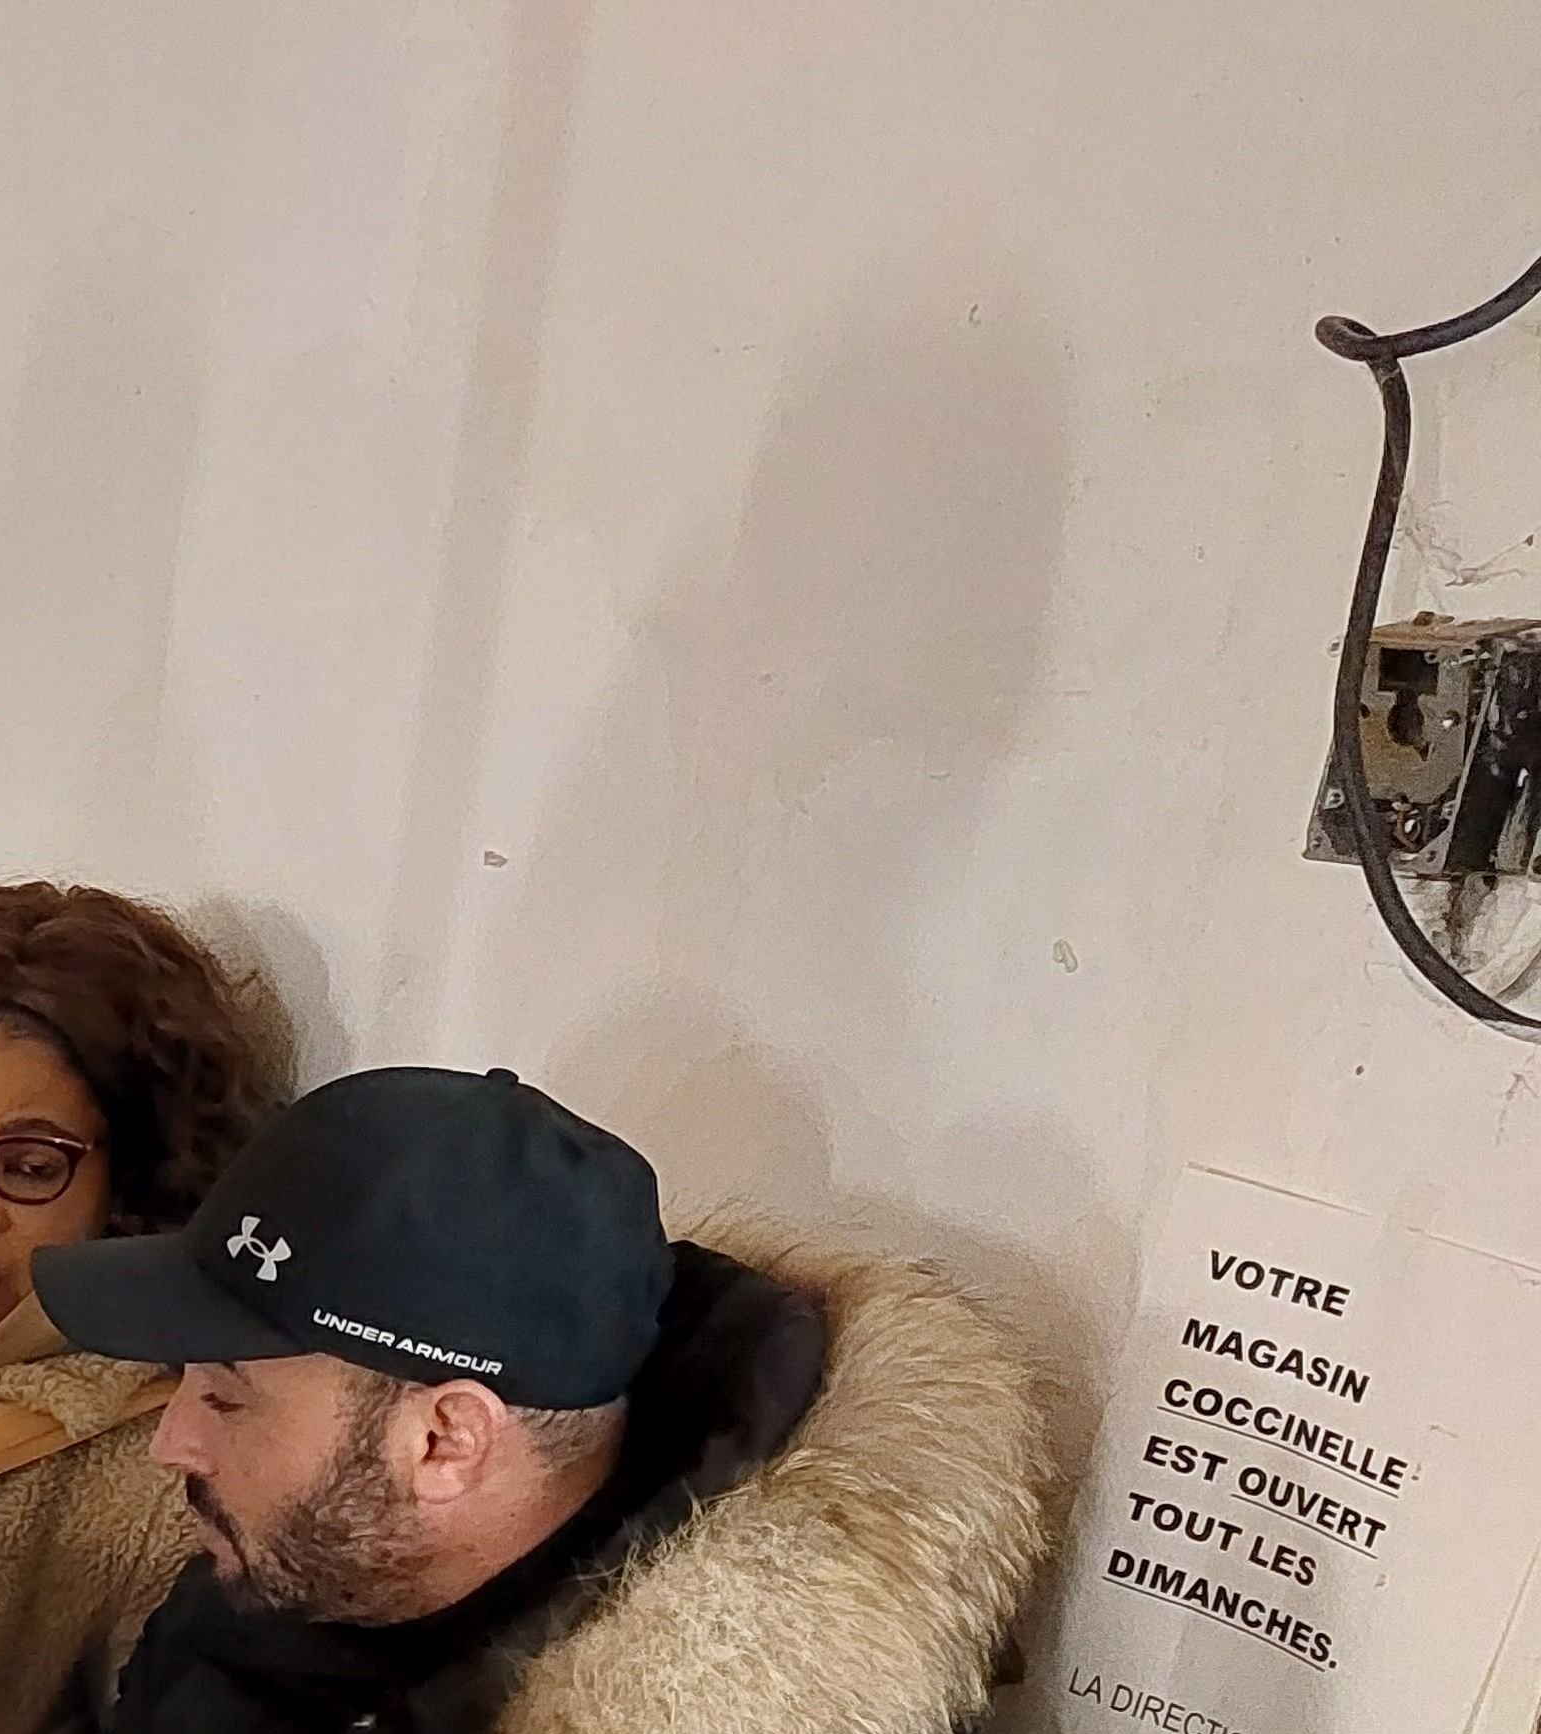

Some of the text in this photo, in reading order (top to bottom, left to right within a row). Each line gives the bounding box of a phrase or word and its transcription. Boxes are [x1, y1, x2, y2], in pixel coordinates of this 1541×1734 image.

[1210, 1250, 1351, 1317] VOTRE
[313, 1309, 504, 1377] UNDER ARMOUR
[1181, 1319, 1370, 1404] MAGASIN
[1163, 1378, 1409, 1490] COCCINELLE
[1143, 1436, 1387, 1551] EST OUVERT
[1127, 1492, 1318, 1588] TOUT LES
[1106, 1548, 1337, 1669] DIMANCHES.
[1068, 1667, 1103, 1705] LA
